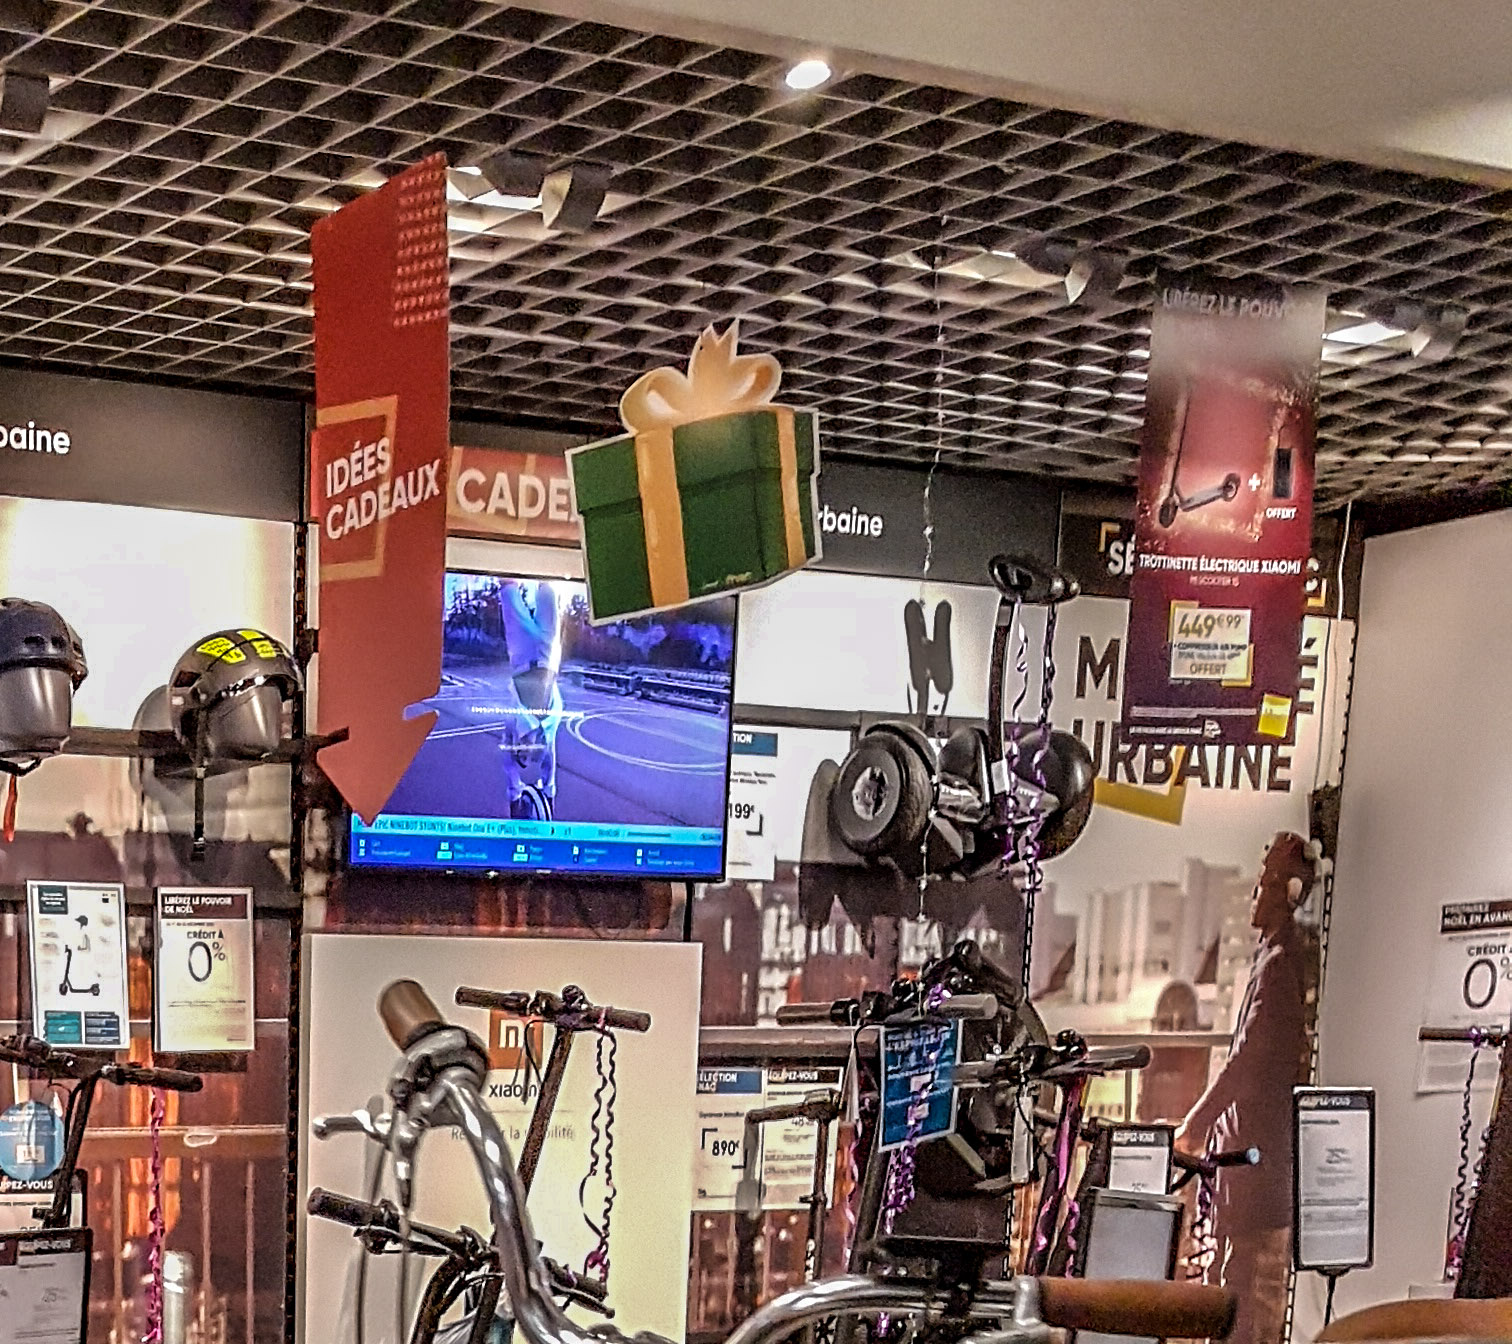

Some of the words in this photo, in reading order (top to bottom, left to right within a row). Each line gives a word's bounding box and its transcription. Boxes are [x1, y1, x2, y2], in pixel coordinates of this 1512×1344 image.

[325, 437, 391, 499] IDÉES
[326, 458, 442, 541] CADEAUX
[456, 468, 575, 523] CADE
[1266, 507, 1297, 520] OFFERT
[1139, 553, 1198, 572] TROTTINETTE
[1199, 555, 1259, 574] ÉLECTRIQUE
[1261, 560, 1302, 575] XIAOMI
[1190, 662, 1227, 676] OFFERT
[187, 929, 217, 940] CRÉDIT
[699, 1071, 737, 1083] ÉLECTION
